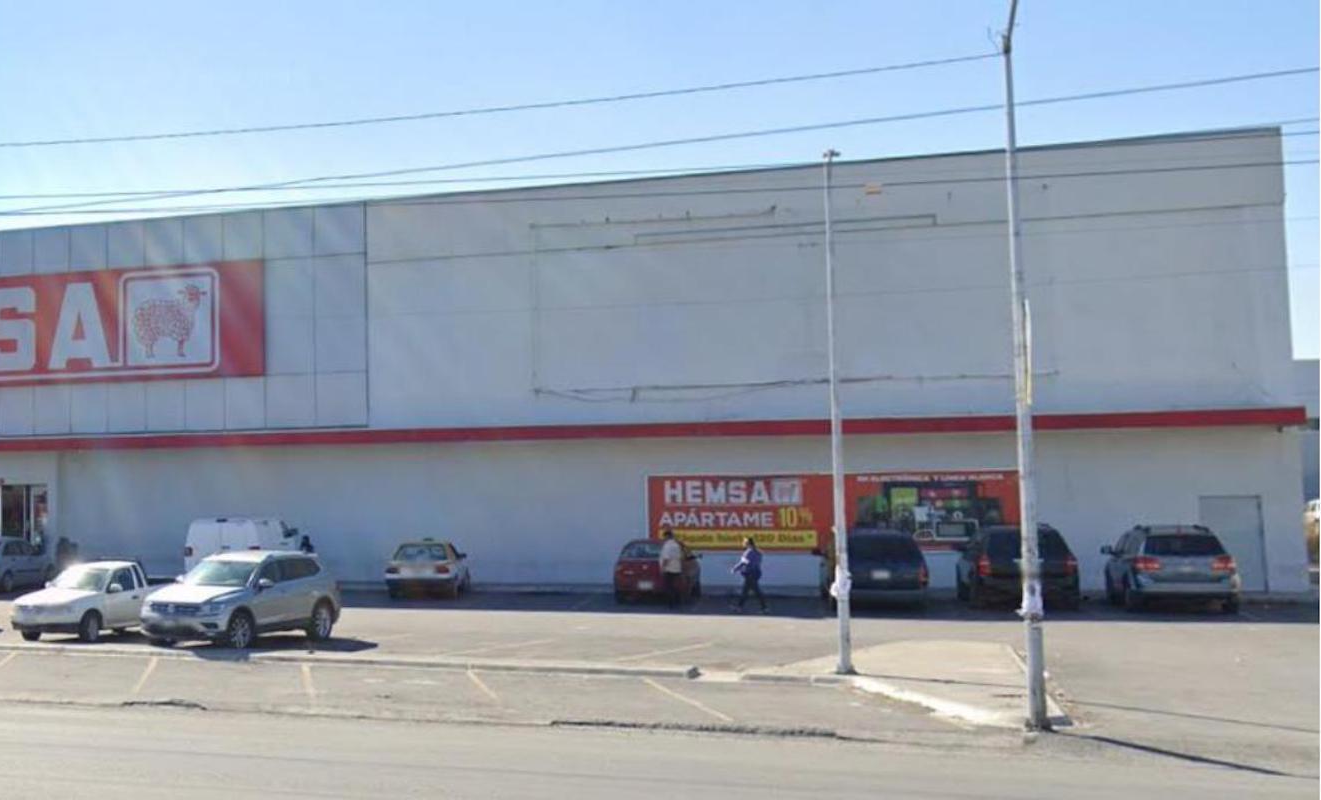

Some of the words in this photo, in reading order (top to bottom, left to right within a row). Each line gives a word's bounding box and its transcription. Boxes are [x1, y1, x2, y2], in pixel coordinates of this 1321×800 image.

[665, 480, 770, 504] HEMSA
[659, 507, 774, 527] APÁRTAME
[779, 506, 812, 528] 10%
